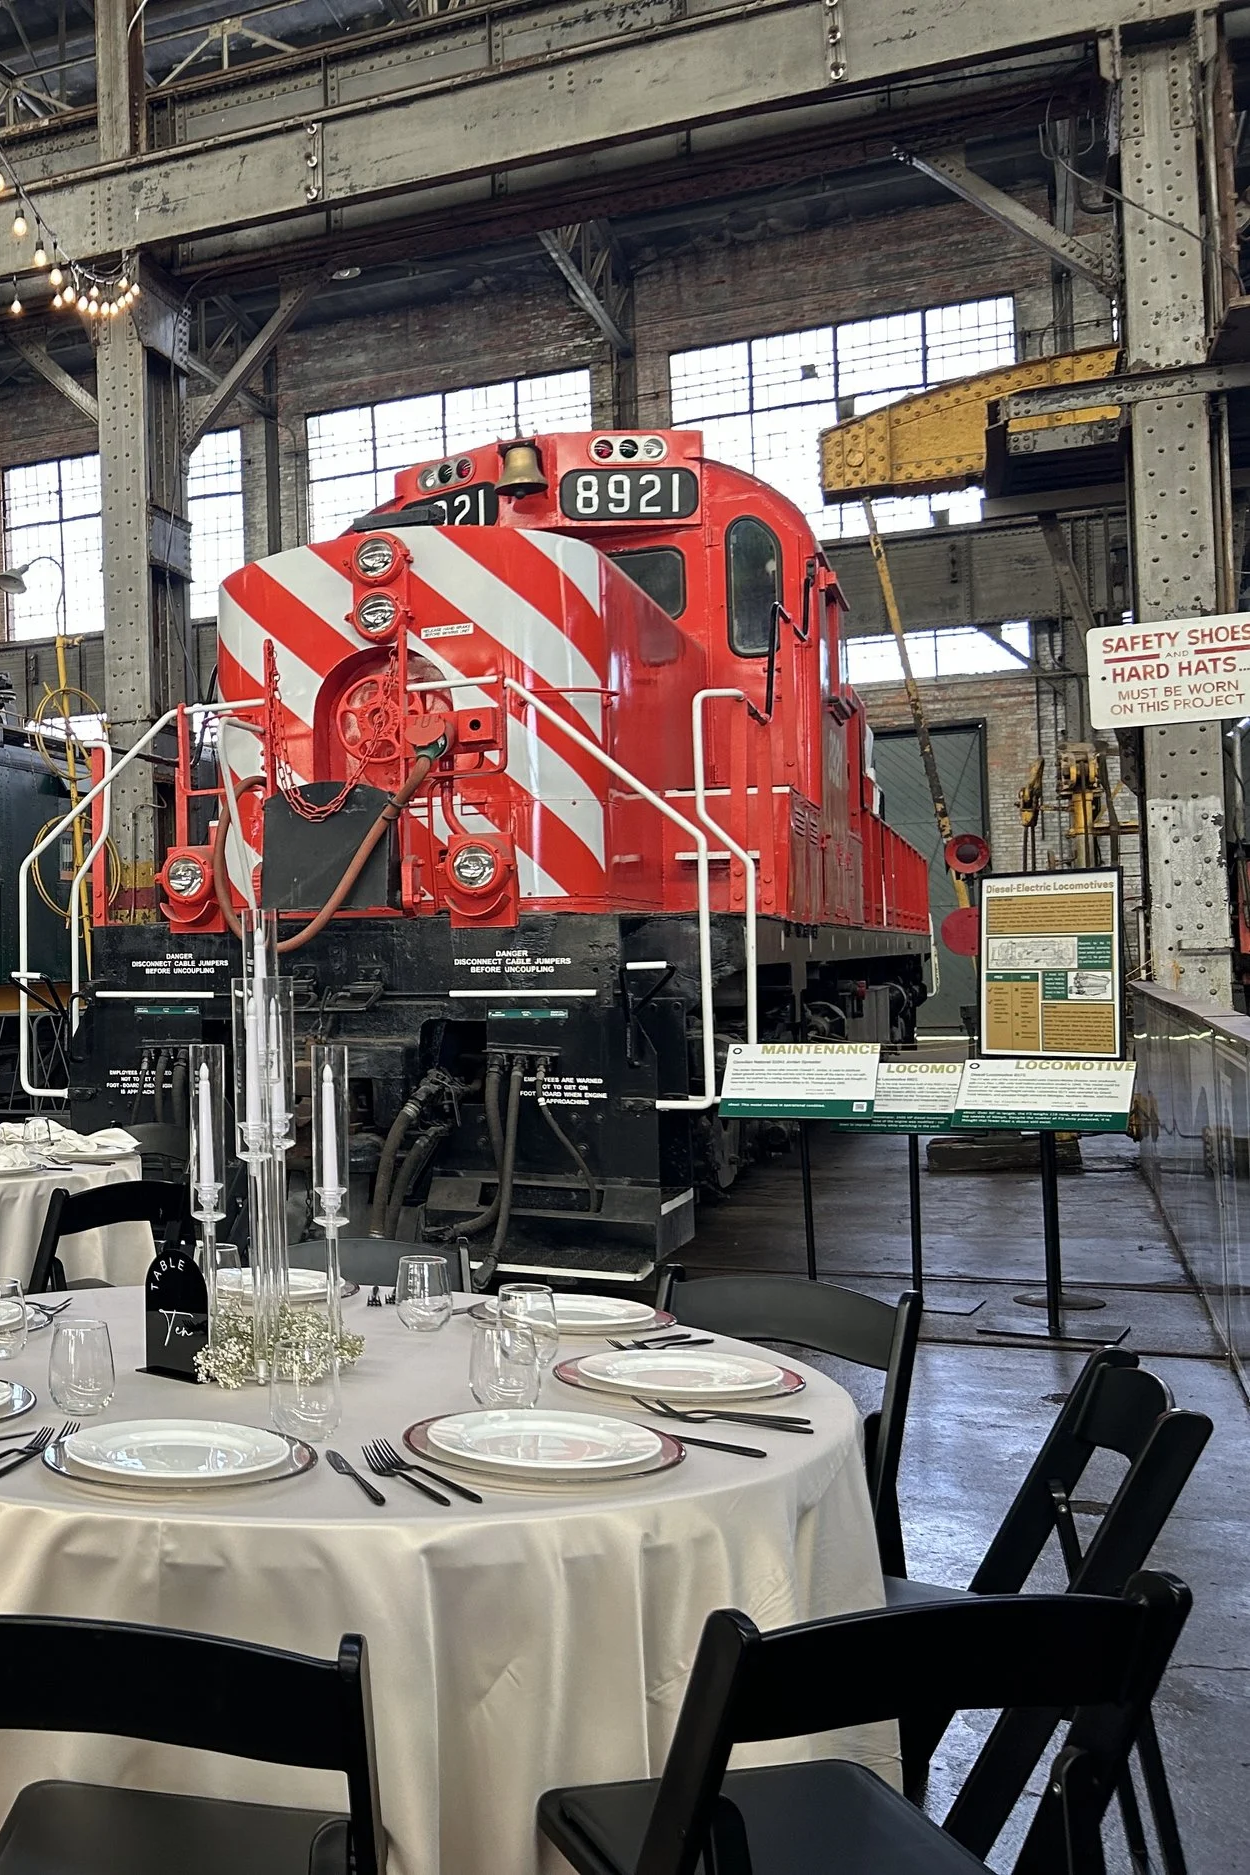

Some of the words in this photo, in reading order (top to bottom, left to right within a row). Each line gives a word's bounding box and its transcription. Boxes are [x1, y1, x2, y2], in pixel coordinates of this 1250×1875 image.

[575, 473, 680, 514] 8921
[1101, 630, 1180, 654] SAFETY
[1187, 623, 1250, 646] SHOES
[1164, 650, 1189, 659] AND
[1112, 662, 1170, 684] HARD
[1117, 687, 1159, 701] MUST
[1163, 685, 1182, 698] BE
[1188, 679, 1239, 695] WORN
[1110, 703, 1134, 716] ON
[1138, 700, 1169, 713] THIS
[1173, 693, 1246, 711] PROJECT
[986, 882, 1051, 894] Diesel-Electric
[1053, 880, 1114, 891] Locomotives
[761, 1044, 880, 1055] MAINTENANCE
[1014, 1061, 1136, 1072] LOCOMOTIVE
[150, 1257, 186, 1291] TABLE
[158, 1308, 194, 1347] Ten
